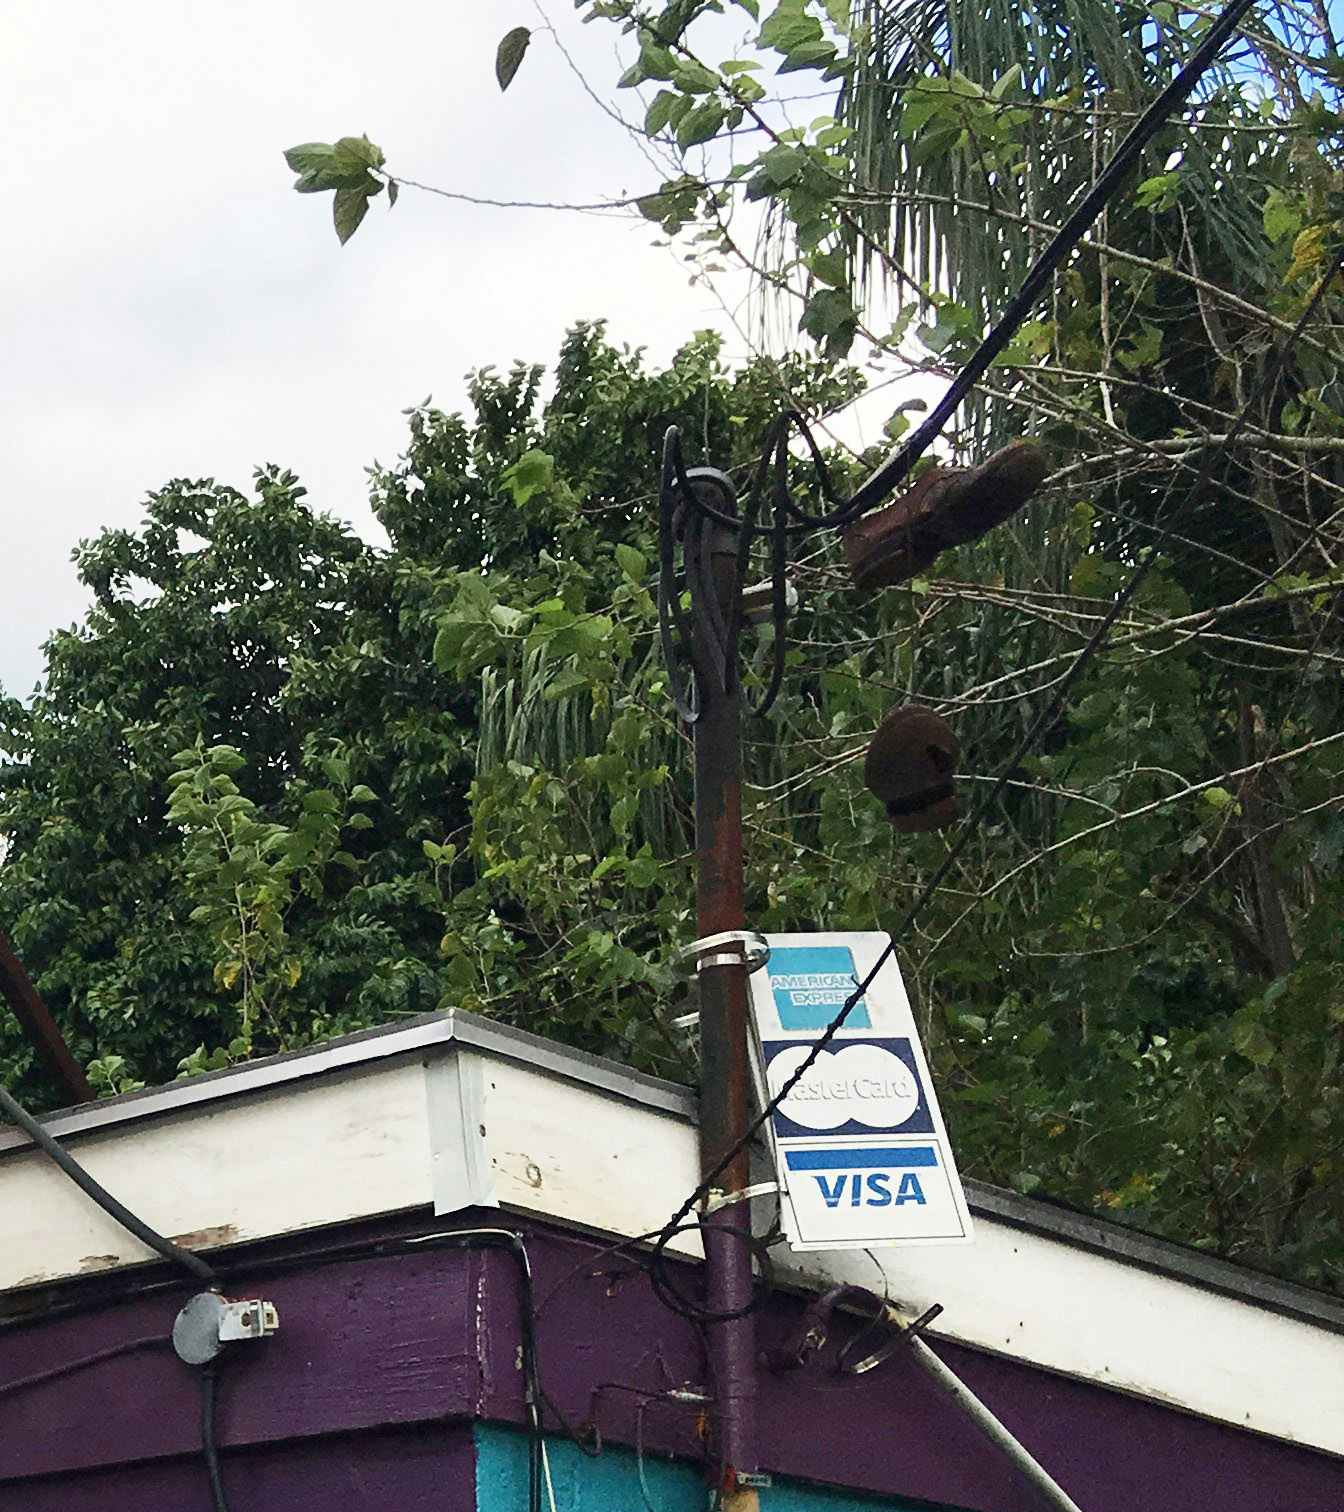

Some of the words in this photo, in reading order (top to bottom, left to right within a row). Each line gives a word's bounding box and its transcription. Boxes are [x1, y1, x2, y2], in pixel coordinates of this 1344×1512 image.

[770, 974, 854, 988] AMERICAN
[792, 991, 854, 1005] EXPRE
[812, 1173, 927, 1208] VISA
